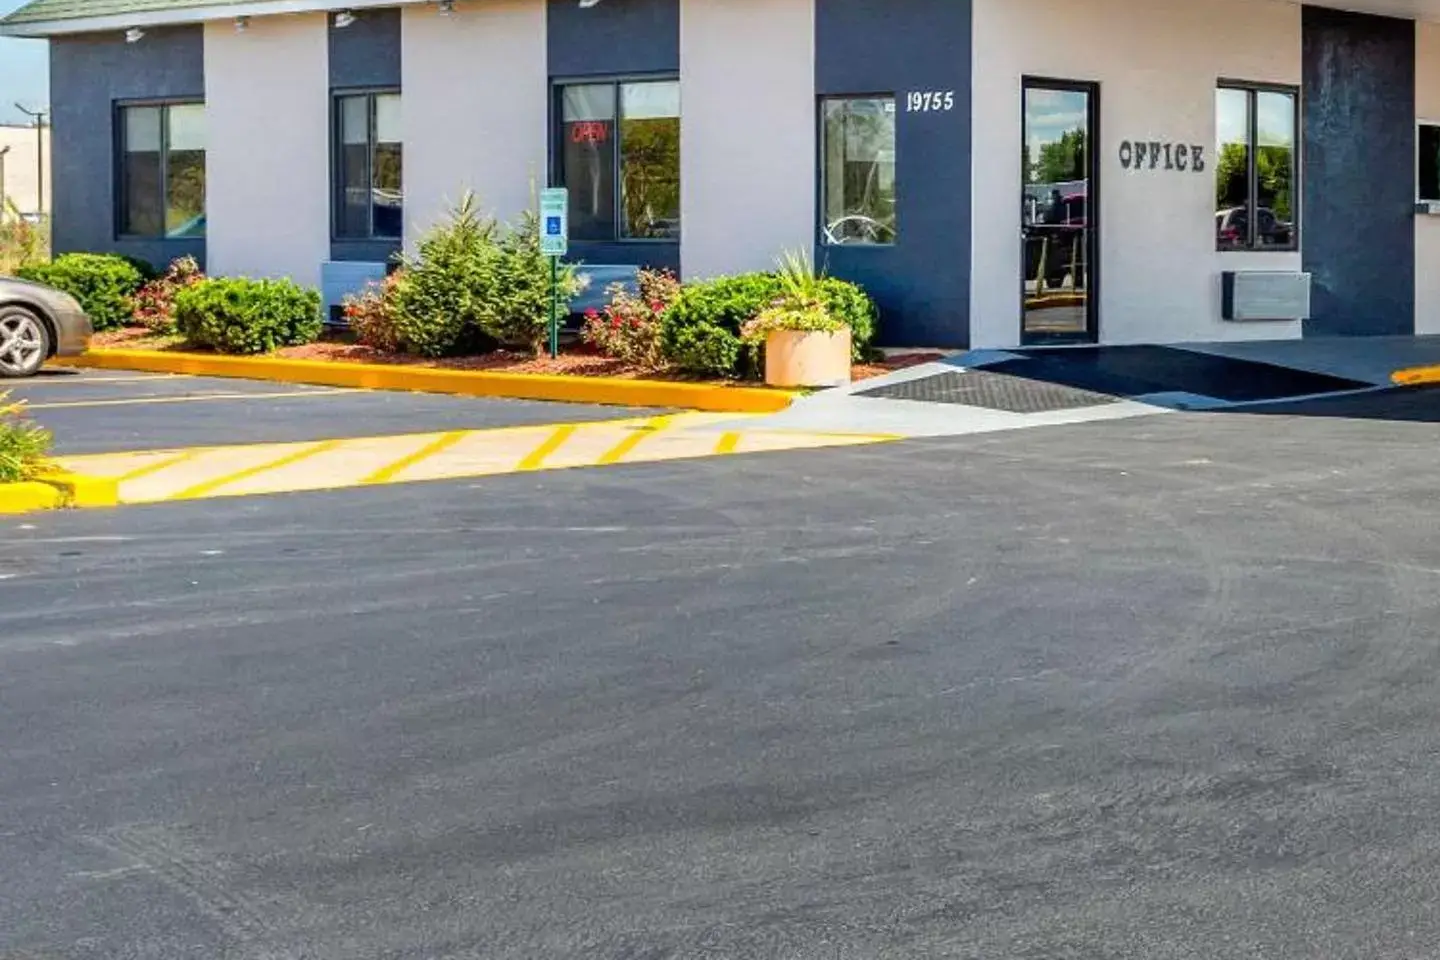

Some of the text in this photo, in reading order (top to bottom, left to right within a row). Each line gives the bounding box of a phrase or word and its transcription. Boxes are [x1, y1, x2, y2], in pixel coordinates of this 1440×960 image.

[906, 91, 954, 113] 19755
[571, 121, 607, 143] OPEN
[1119, 140, 1204, 172] OFFICE
